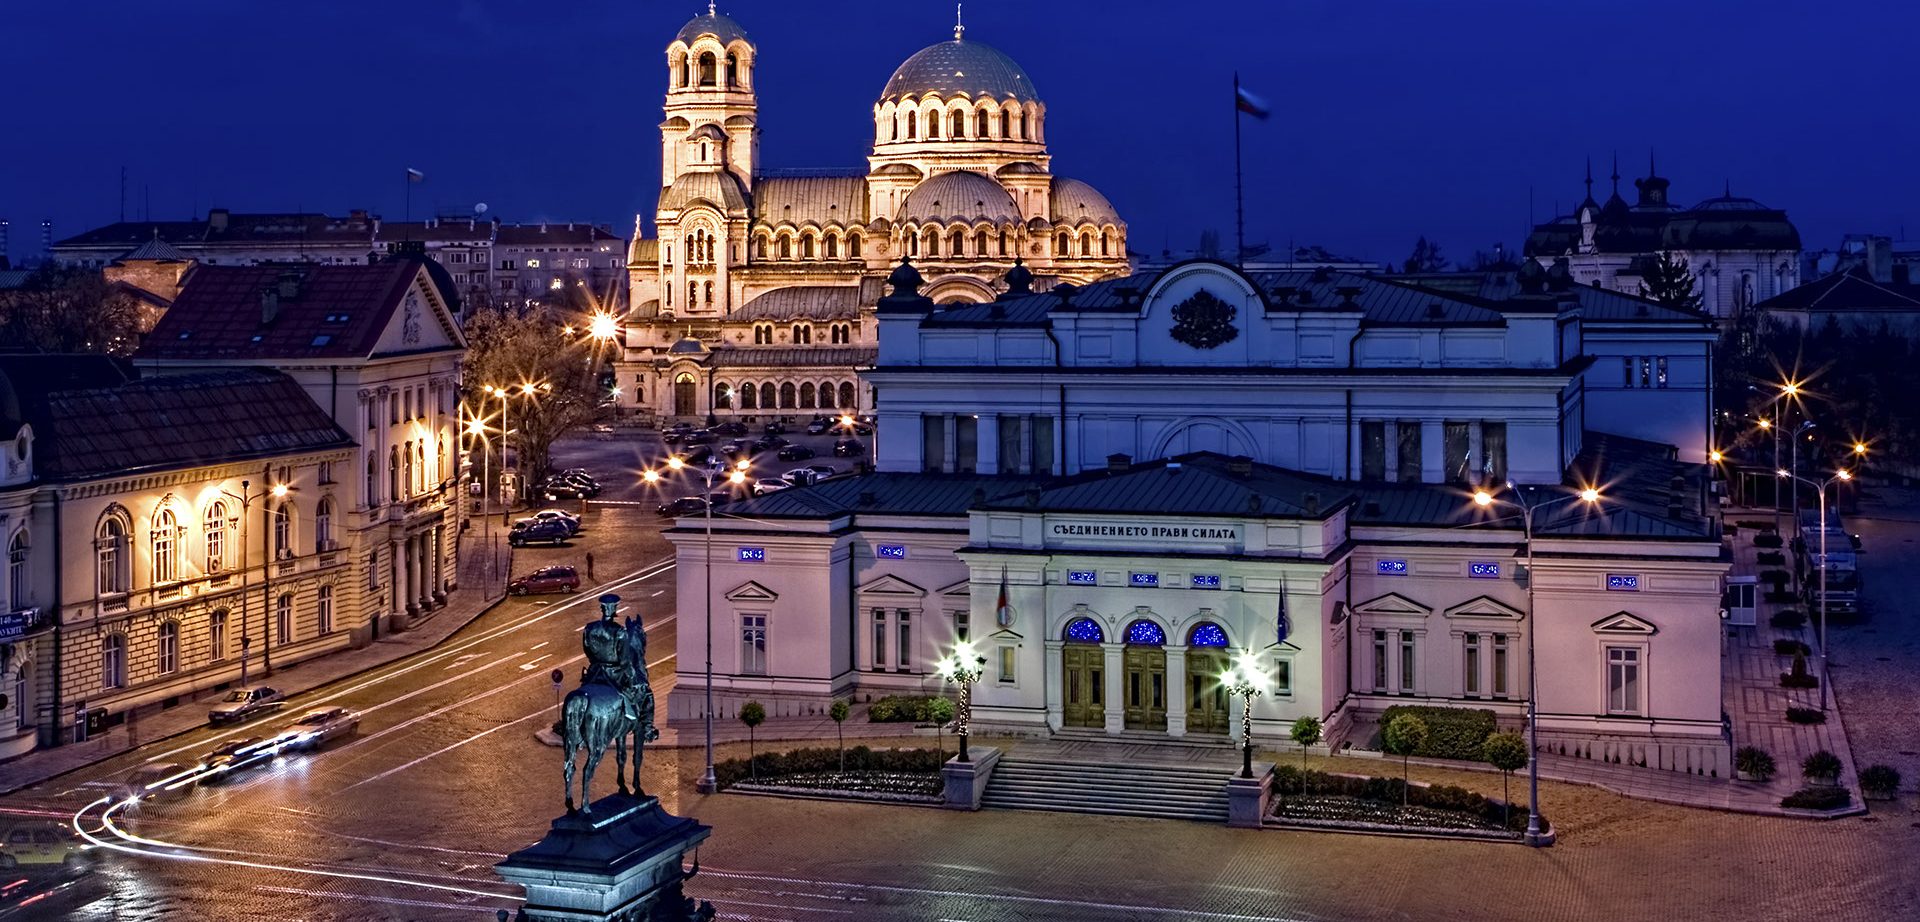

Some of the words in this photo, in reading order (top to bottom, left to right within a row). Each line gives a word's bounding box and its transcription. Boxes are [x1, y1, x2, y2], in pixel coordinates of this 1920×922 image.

[1053, 525, 1148, 537] СЪЕДИНЕНИЕТО
[1151, 527, 1188, 538] ПРАВИ
[1192, 528, 1236, 539] СИЛАТА
